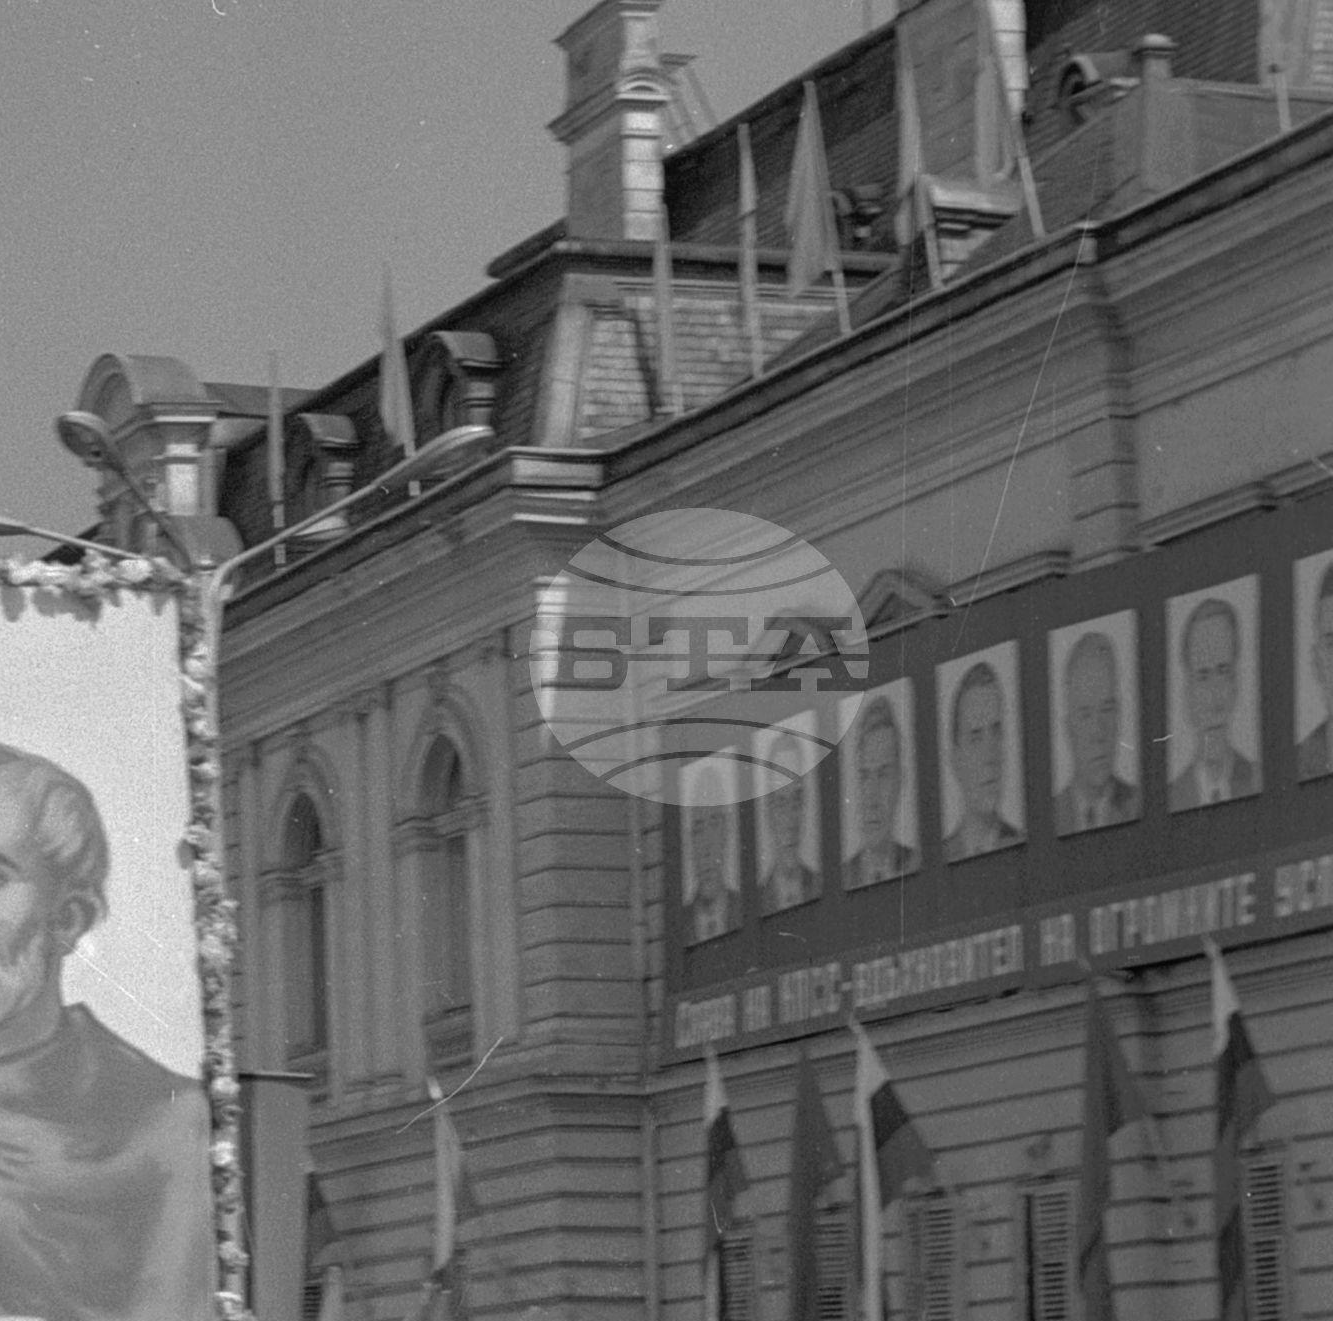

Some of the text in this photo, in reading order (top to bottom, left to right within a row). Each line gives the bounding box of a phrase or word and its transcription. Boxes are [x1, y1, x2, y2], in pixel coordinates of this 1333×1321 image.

[852, 924, 1024, 1010] ВДЪХНОВИТЕЛ
[1039, 913, 1077, 967] НА
[1088, 872, 1256, 955] ОГРОМНИТЕ
